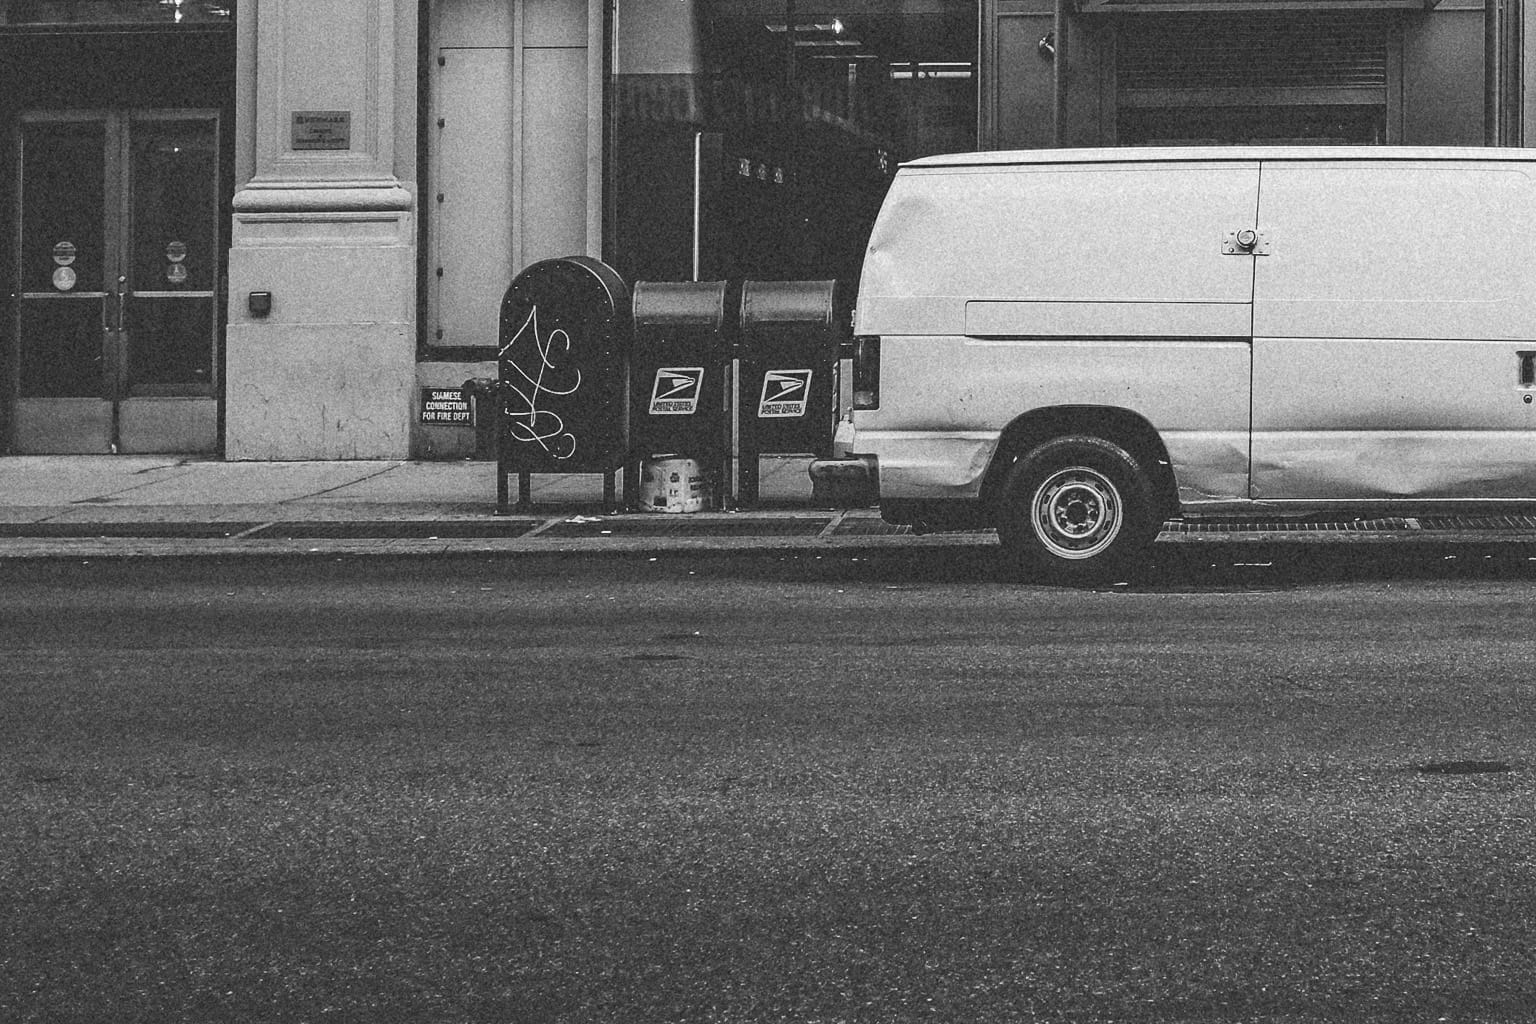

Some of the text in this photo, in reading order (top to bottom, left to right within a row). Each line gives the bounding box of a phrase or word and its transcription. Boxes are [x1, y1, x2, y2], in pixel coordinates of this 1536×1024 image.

[431, 391, 462, 401] SIAMESE
[425, 401, 468, 410] CONNECTION
[422, 411, 470, 421] FOR FIRE DEPT
